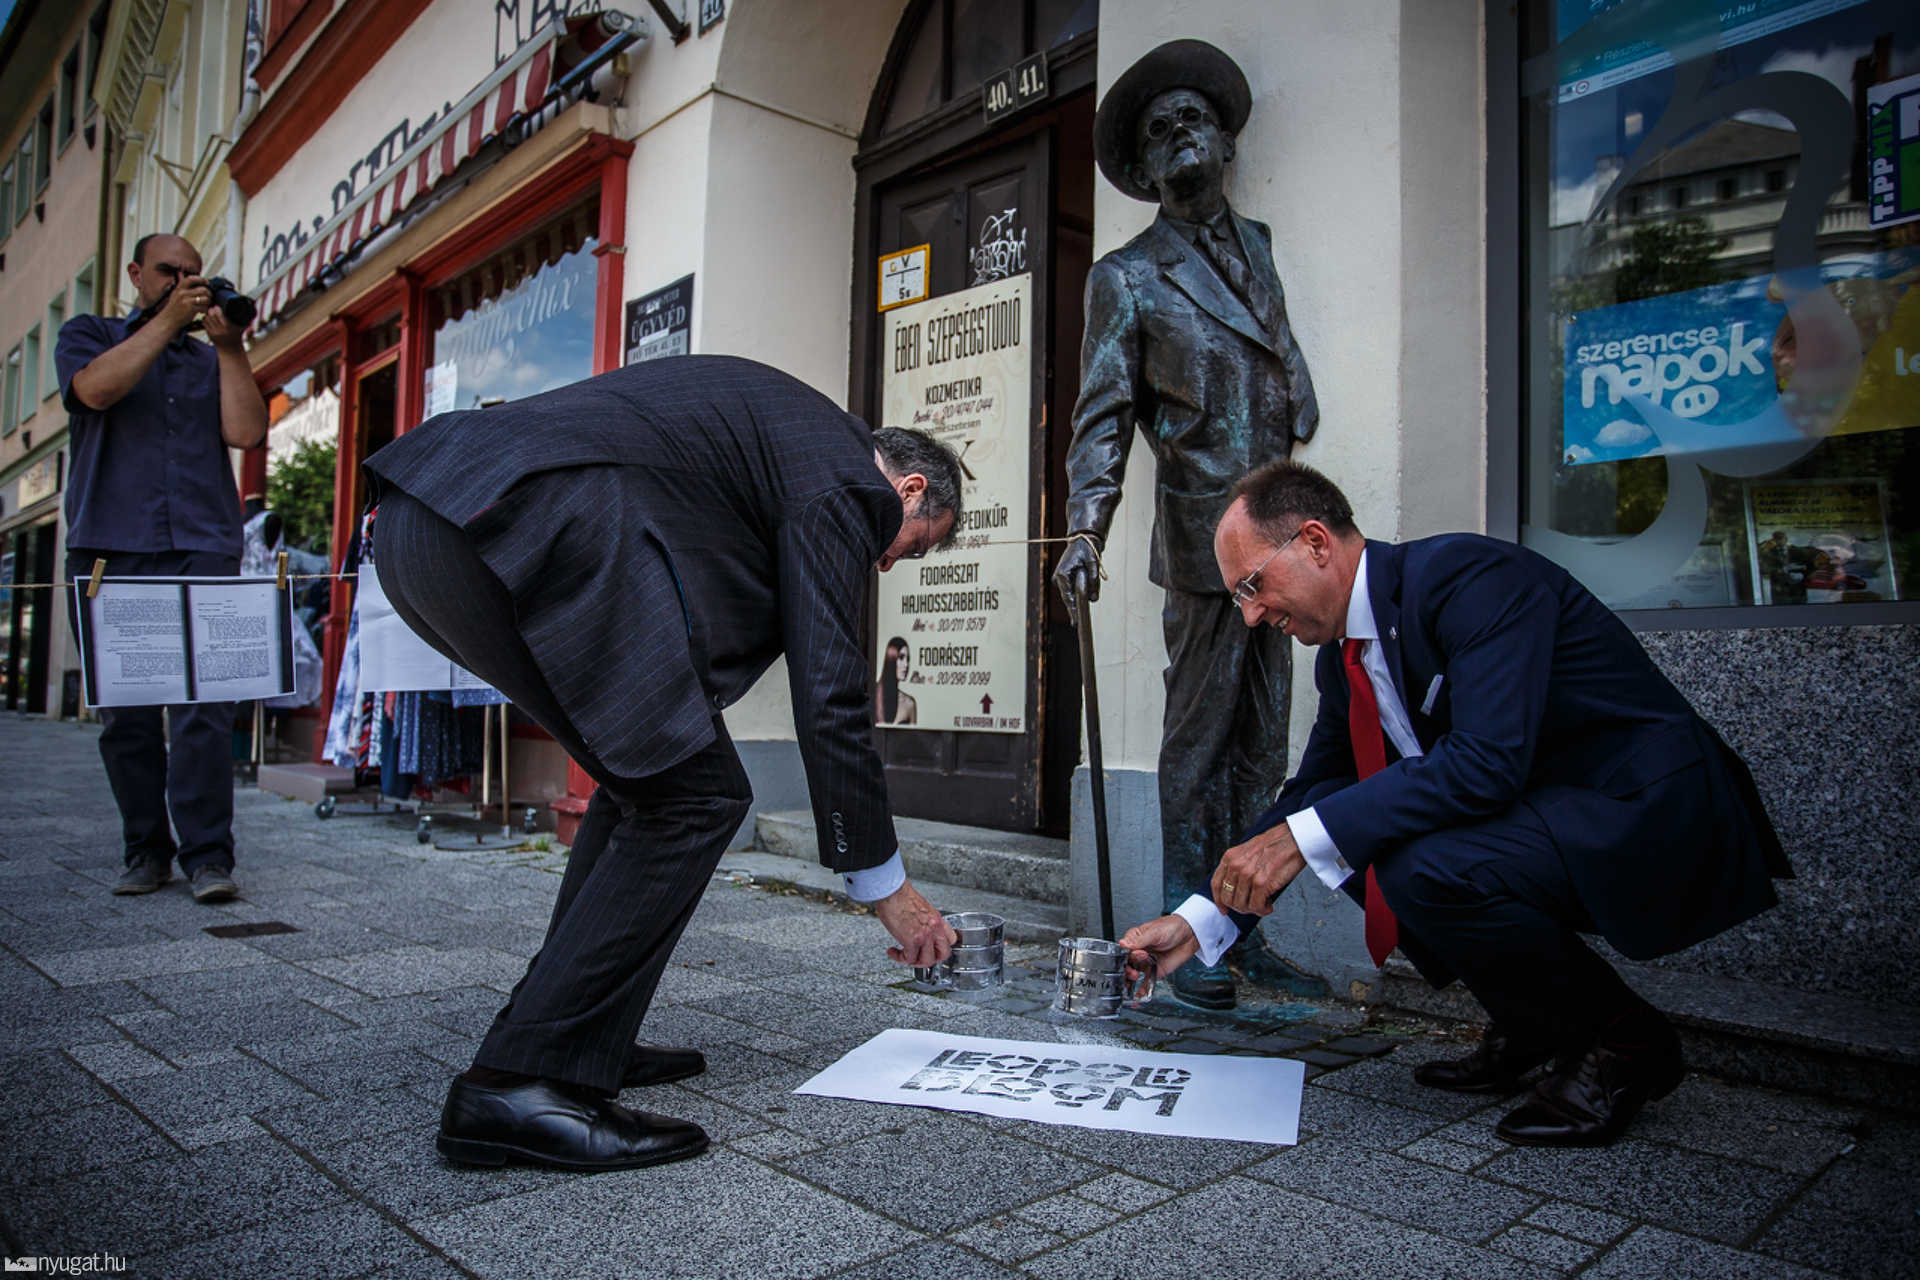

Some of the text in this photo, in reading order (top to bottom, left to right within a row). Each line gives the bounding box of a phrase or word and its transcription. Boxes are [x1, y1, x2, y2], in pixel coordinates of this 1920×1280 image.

[987, 64, 1044, 112] 40. 41.
[901, 255, 911, 269] V
[895, 288, 1021, 374] ÉBEN SZÉPSÉGSTÚDIÓ
[1577, 326, 1720, 364] szerencse
[1581, 322, 1766, 409] napok
[925, 376, 982, 406] KOZMETIKA
[920, 560, 979, 587] FODRÁSZAT
[902, 586, 999, 614] HAJHOSSZABBÍTÁS
[919, 642, 979, 667] FODRÁSZAT
[923, 1049, 1192, 1091] LEOPOLD
[899, 1068, 1182, 1117] BLOOM
